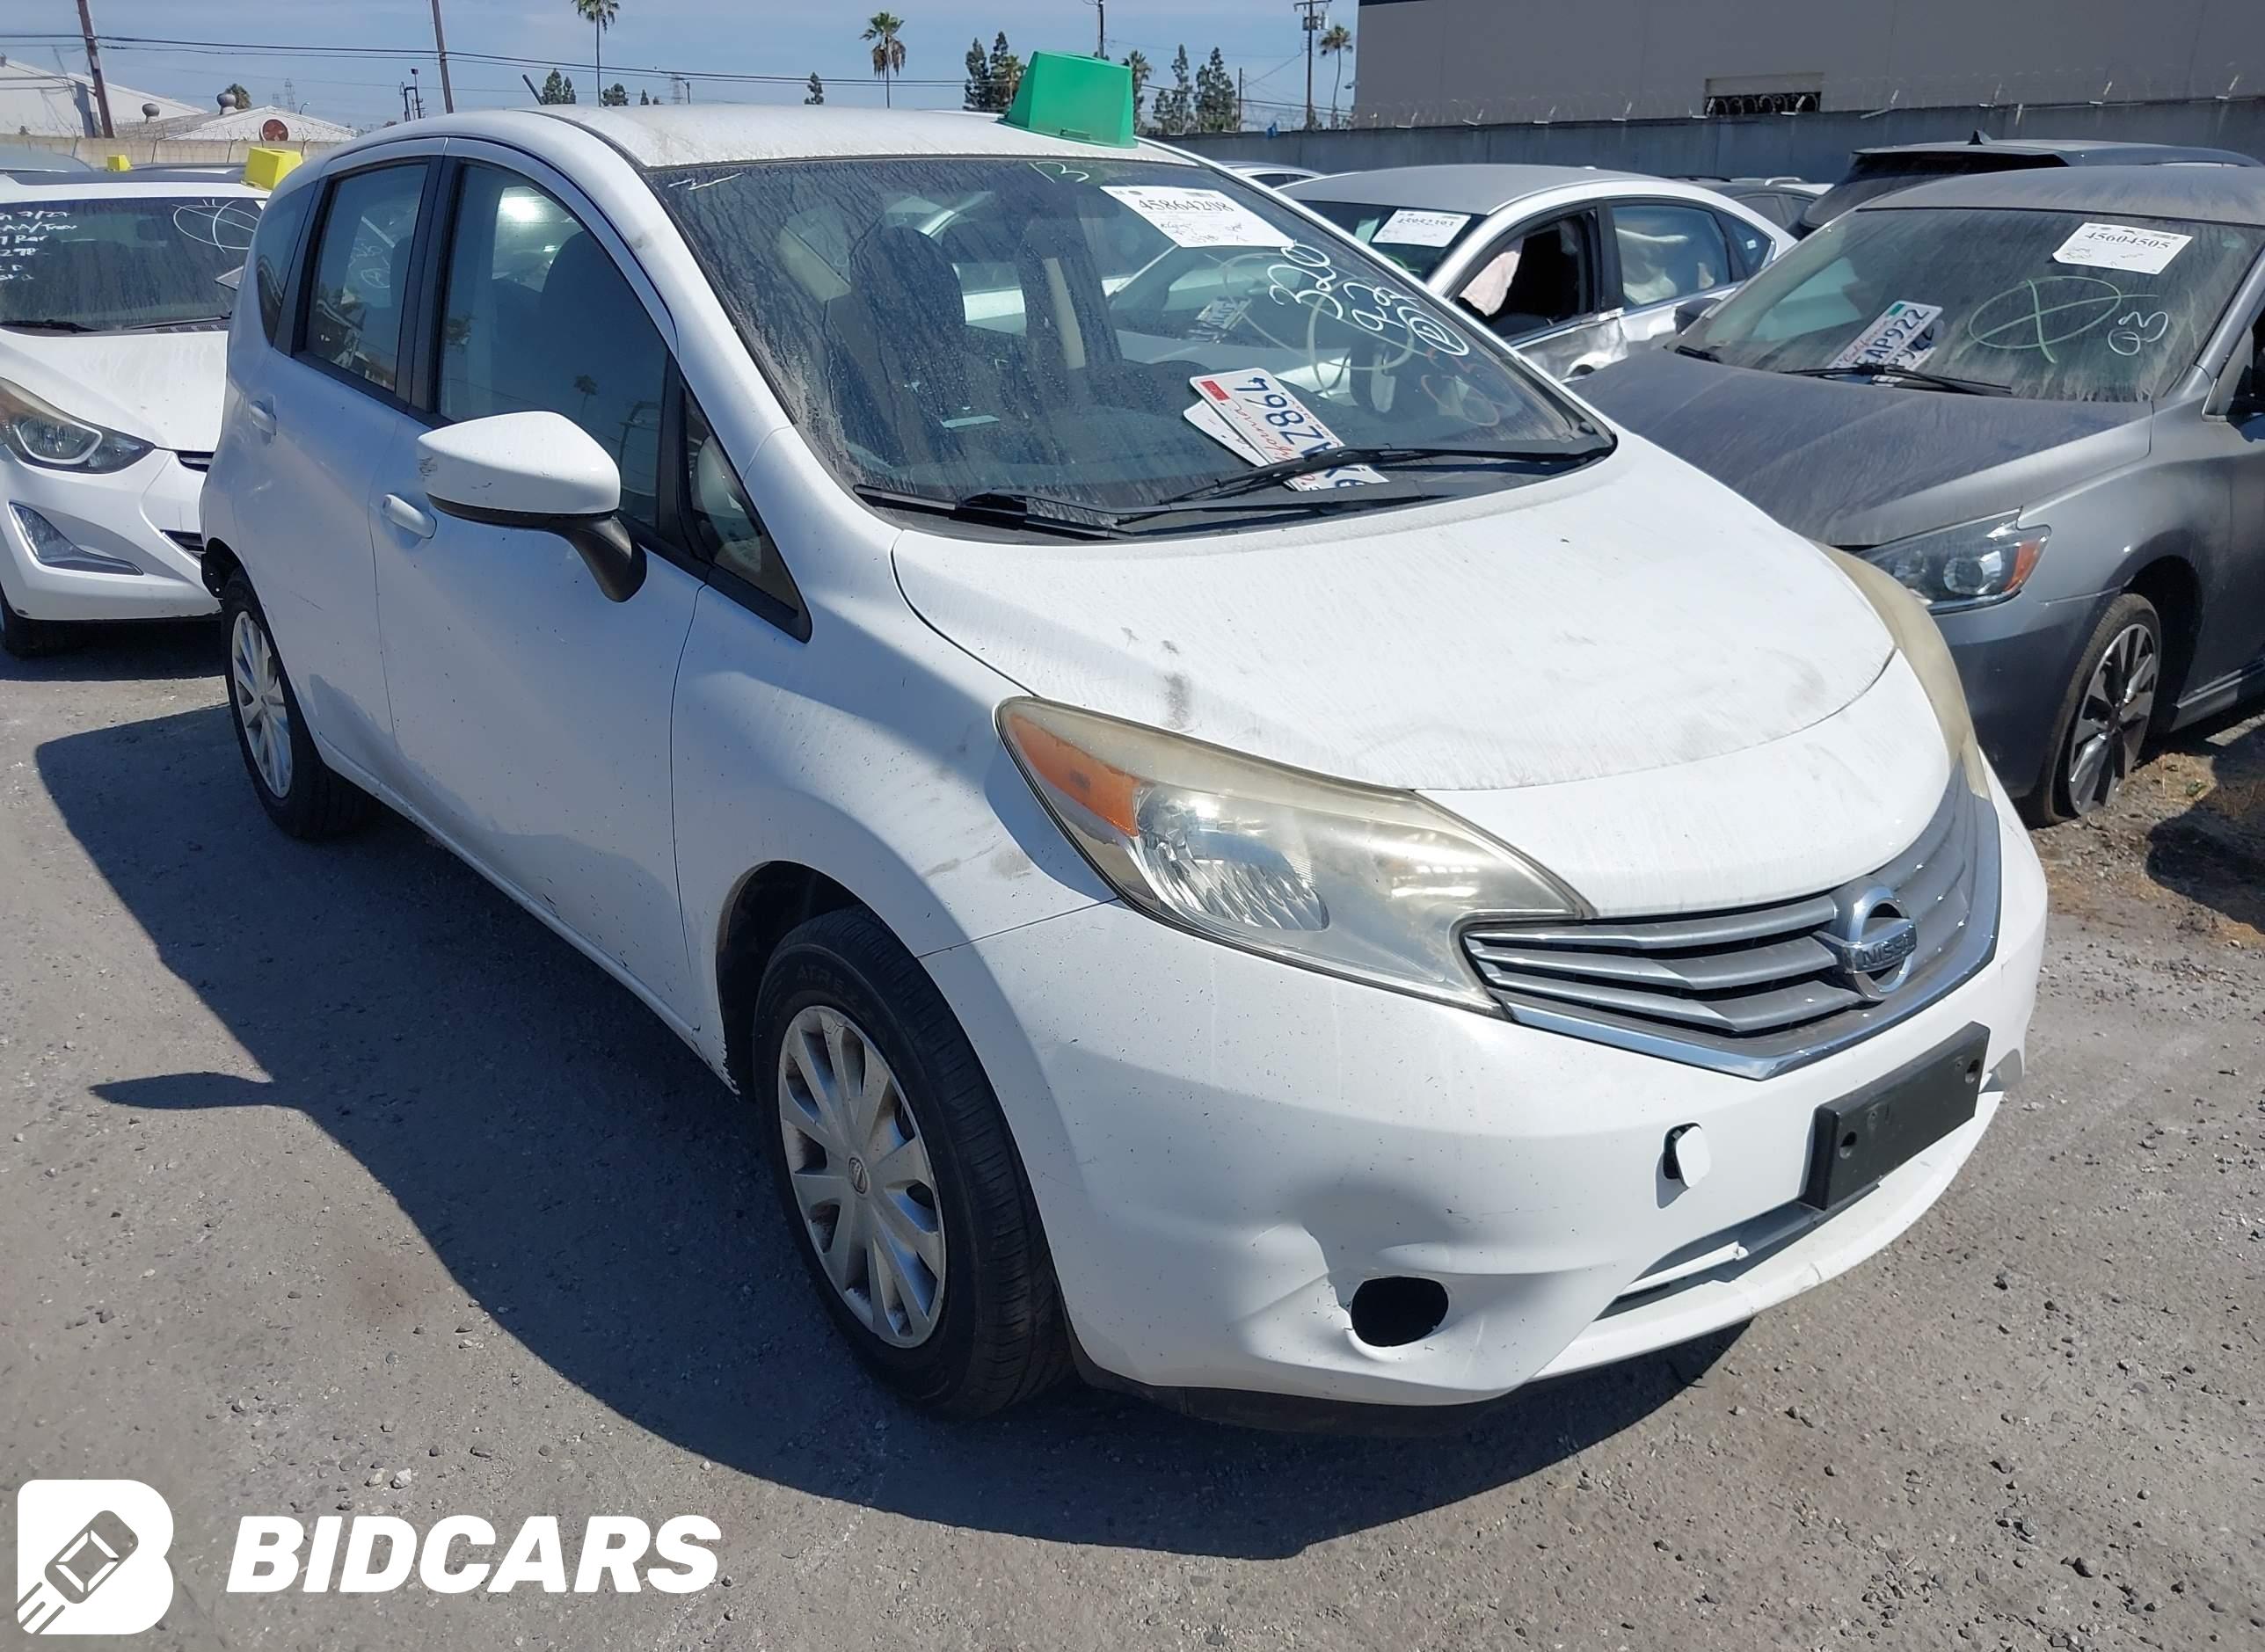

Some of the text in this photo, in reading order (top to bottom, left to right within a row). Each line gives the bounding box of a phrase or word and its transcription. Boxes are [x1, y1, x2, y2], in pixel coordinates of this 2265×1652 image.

[1139, 199, 1235, 212] 45864208
[2085, 231, 2172, 250] 45604505
[1853, 309, 1930, 365] EAP922
